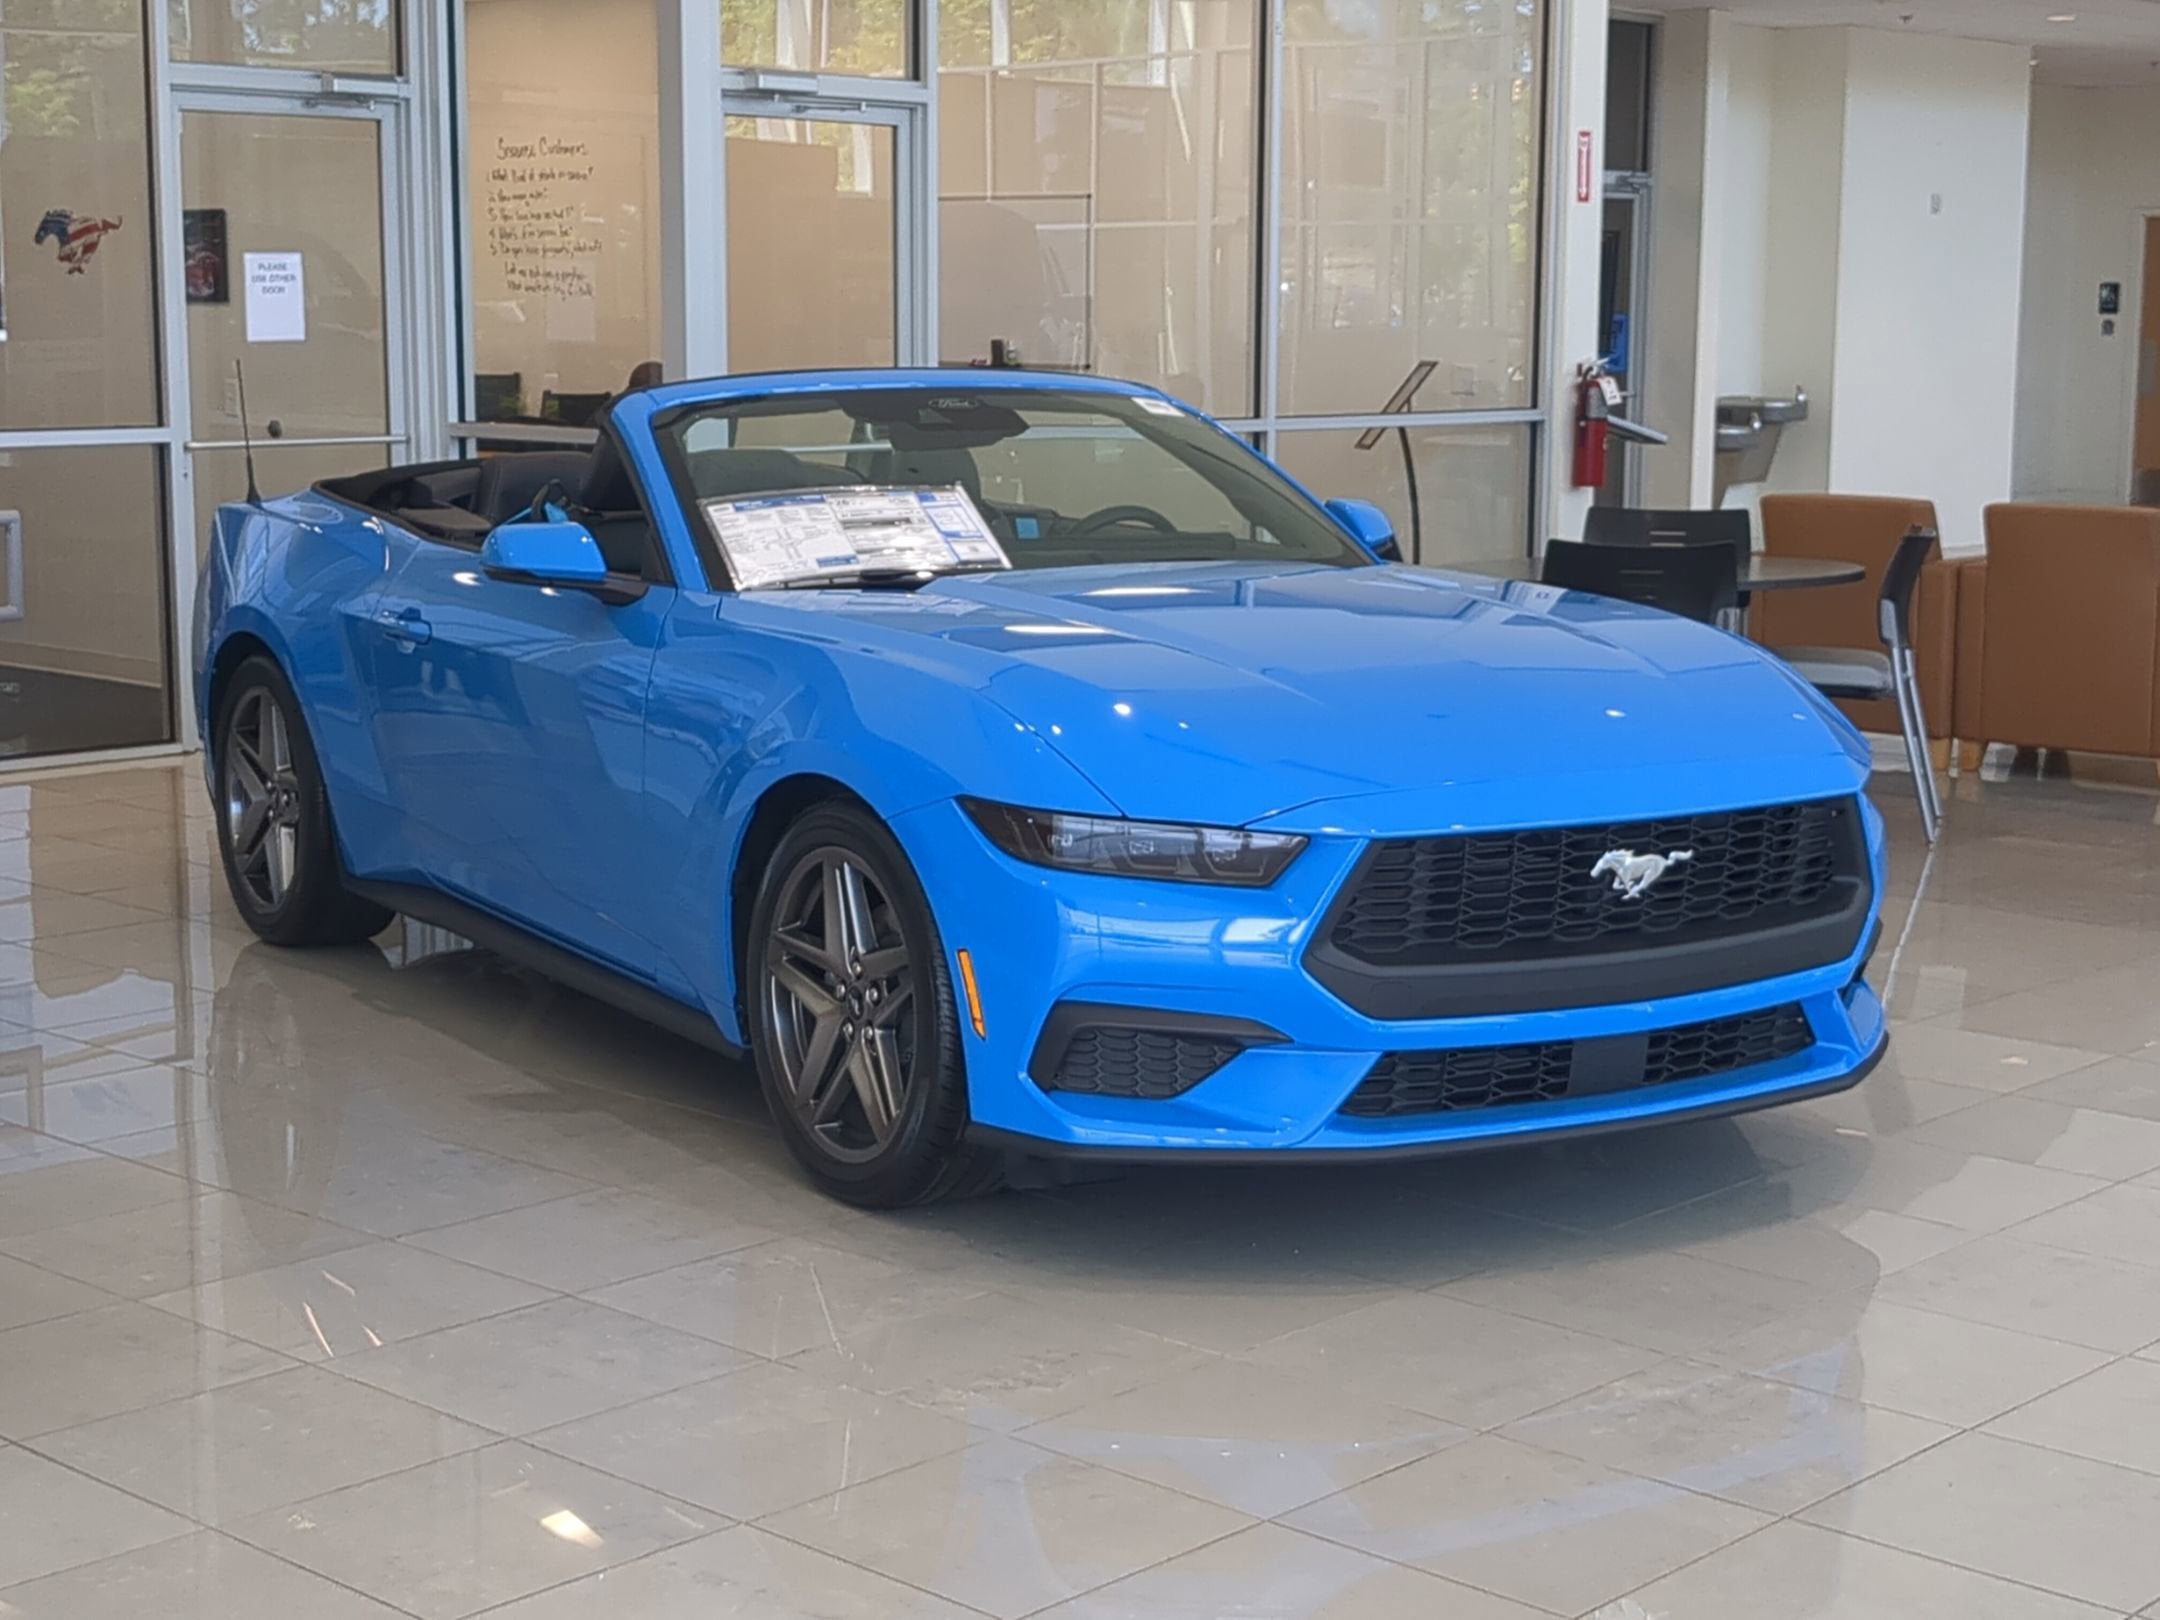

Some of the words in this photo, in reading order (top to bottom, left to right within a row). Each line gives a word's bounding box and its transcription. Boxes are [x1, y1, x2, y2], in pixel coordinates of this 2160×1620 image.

[257, 262, 287, 271] PLEASE
[269, 274, 296, 283] OTHER
[261, 286, 285, 294] DOOR
